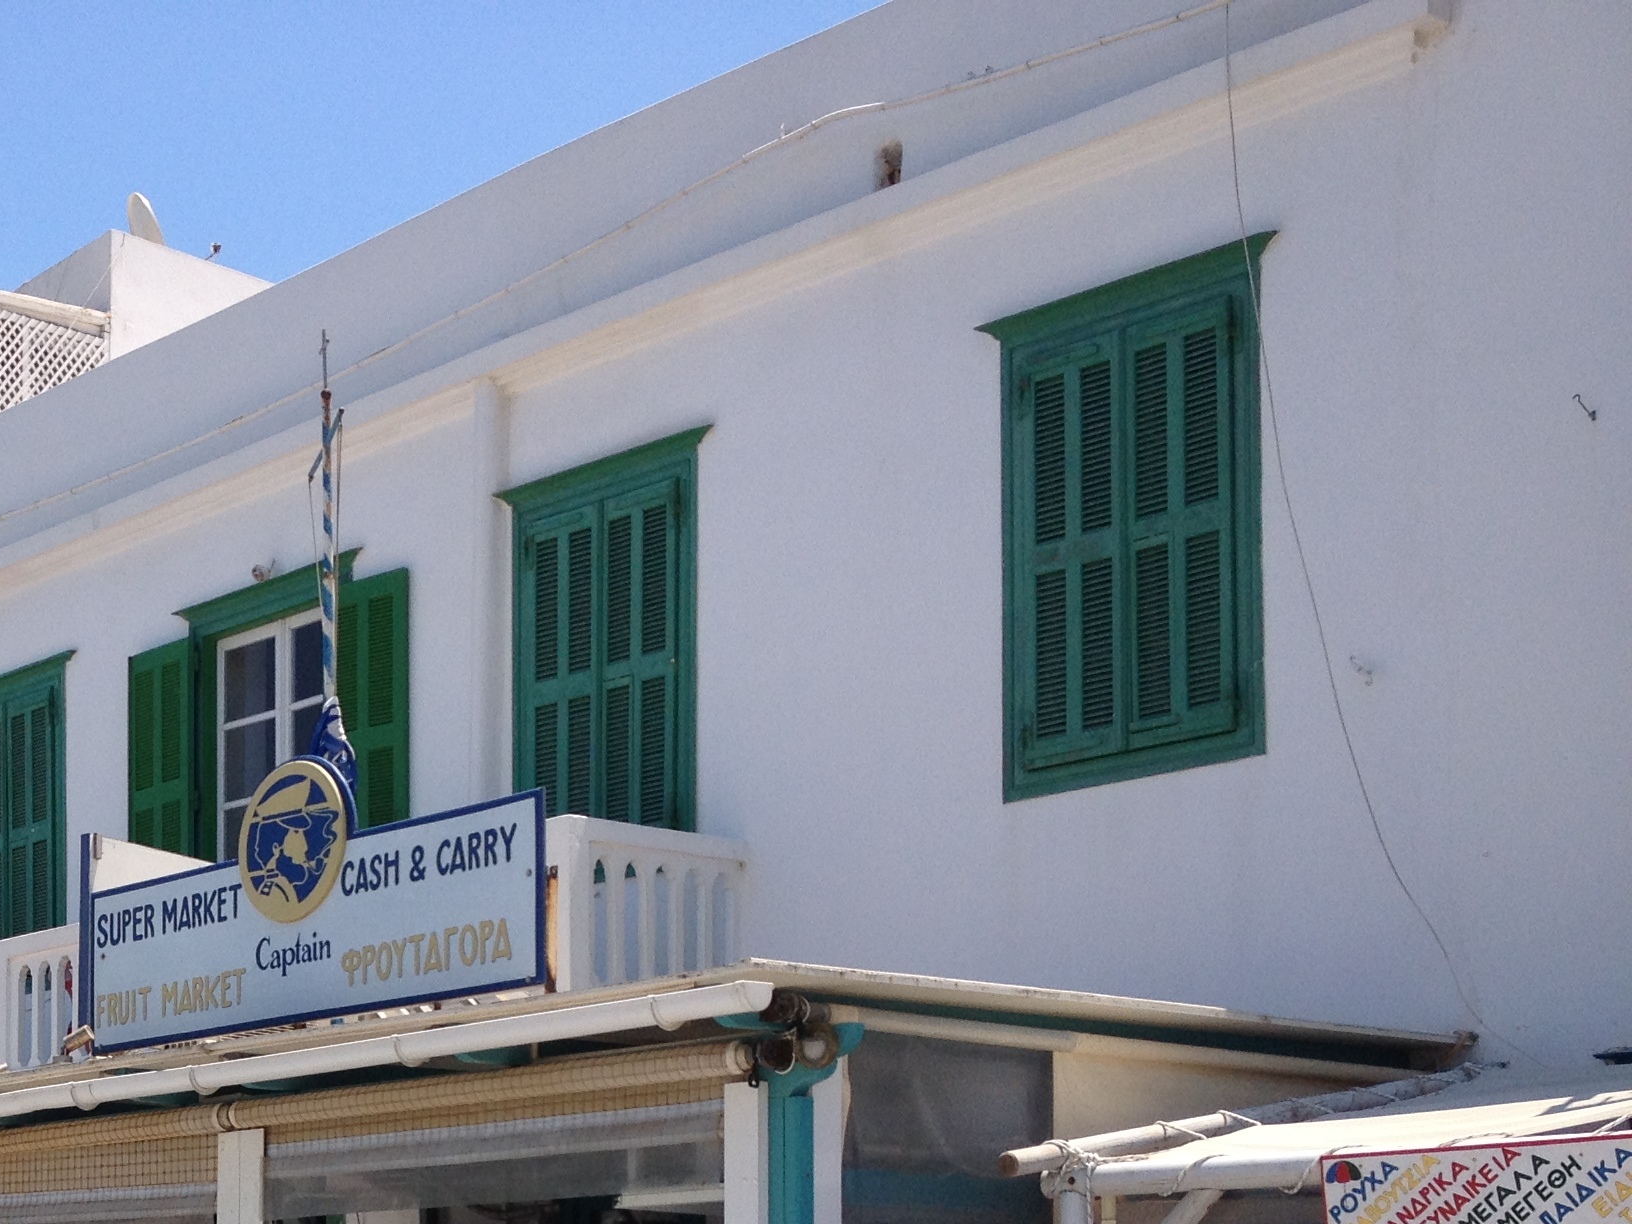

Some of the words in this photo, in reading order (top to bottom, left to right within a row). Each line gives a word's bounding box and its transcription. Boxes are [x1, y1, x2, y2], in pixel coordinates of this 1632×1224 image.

[341, 848, 400, 897] CASH
[410, 844, 427, 882] &
[435, 822, 518, 876] CARRY
[96, 907, 155, 949] SUPER
[161, 883, 242, 934] MARKET
[256, 931, 331, 977] Captain
[341, 918, 512, 987] ΦΡΟΥΤΑΓΟΡΑ
[96, 985, 151, 1029] FRUIT
[161, 967, 246, 1017] MARKET
[1329, 1161, 1399, 1224] ΡΟΥΧΑ
